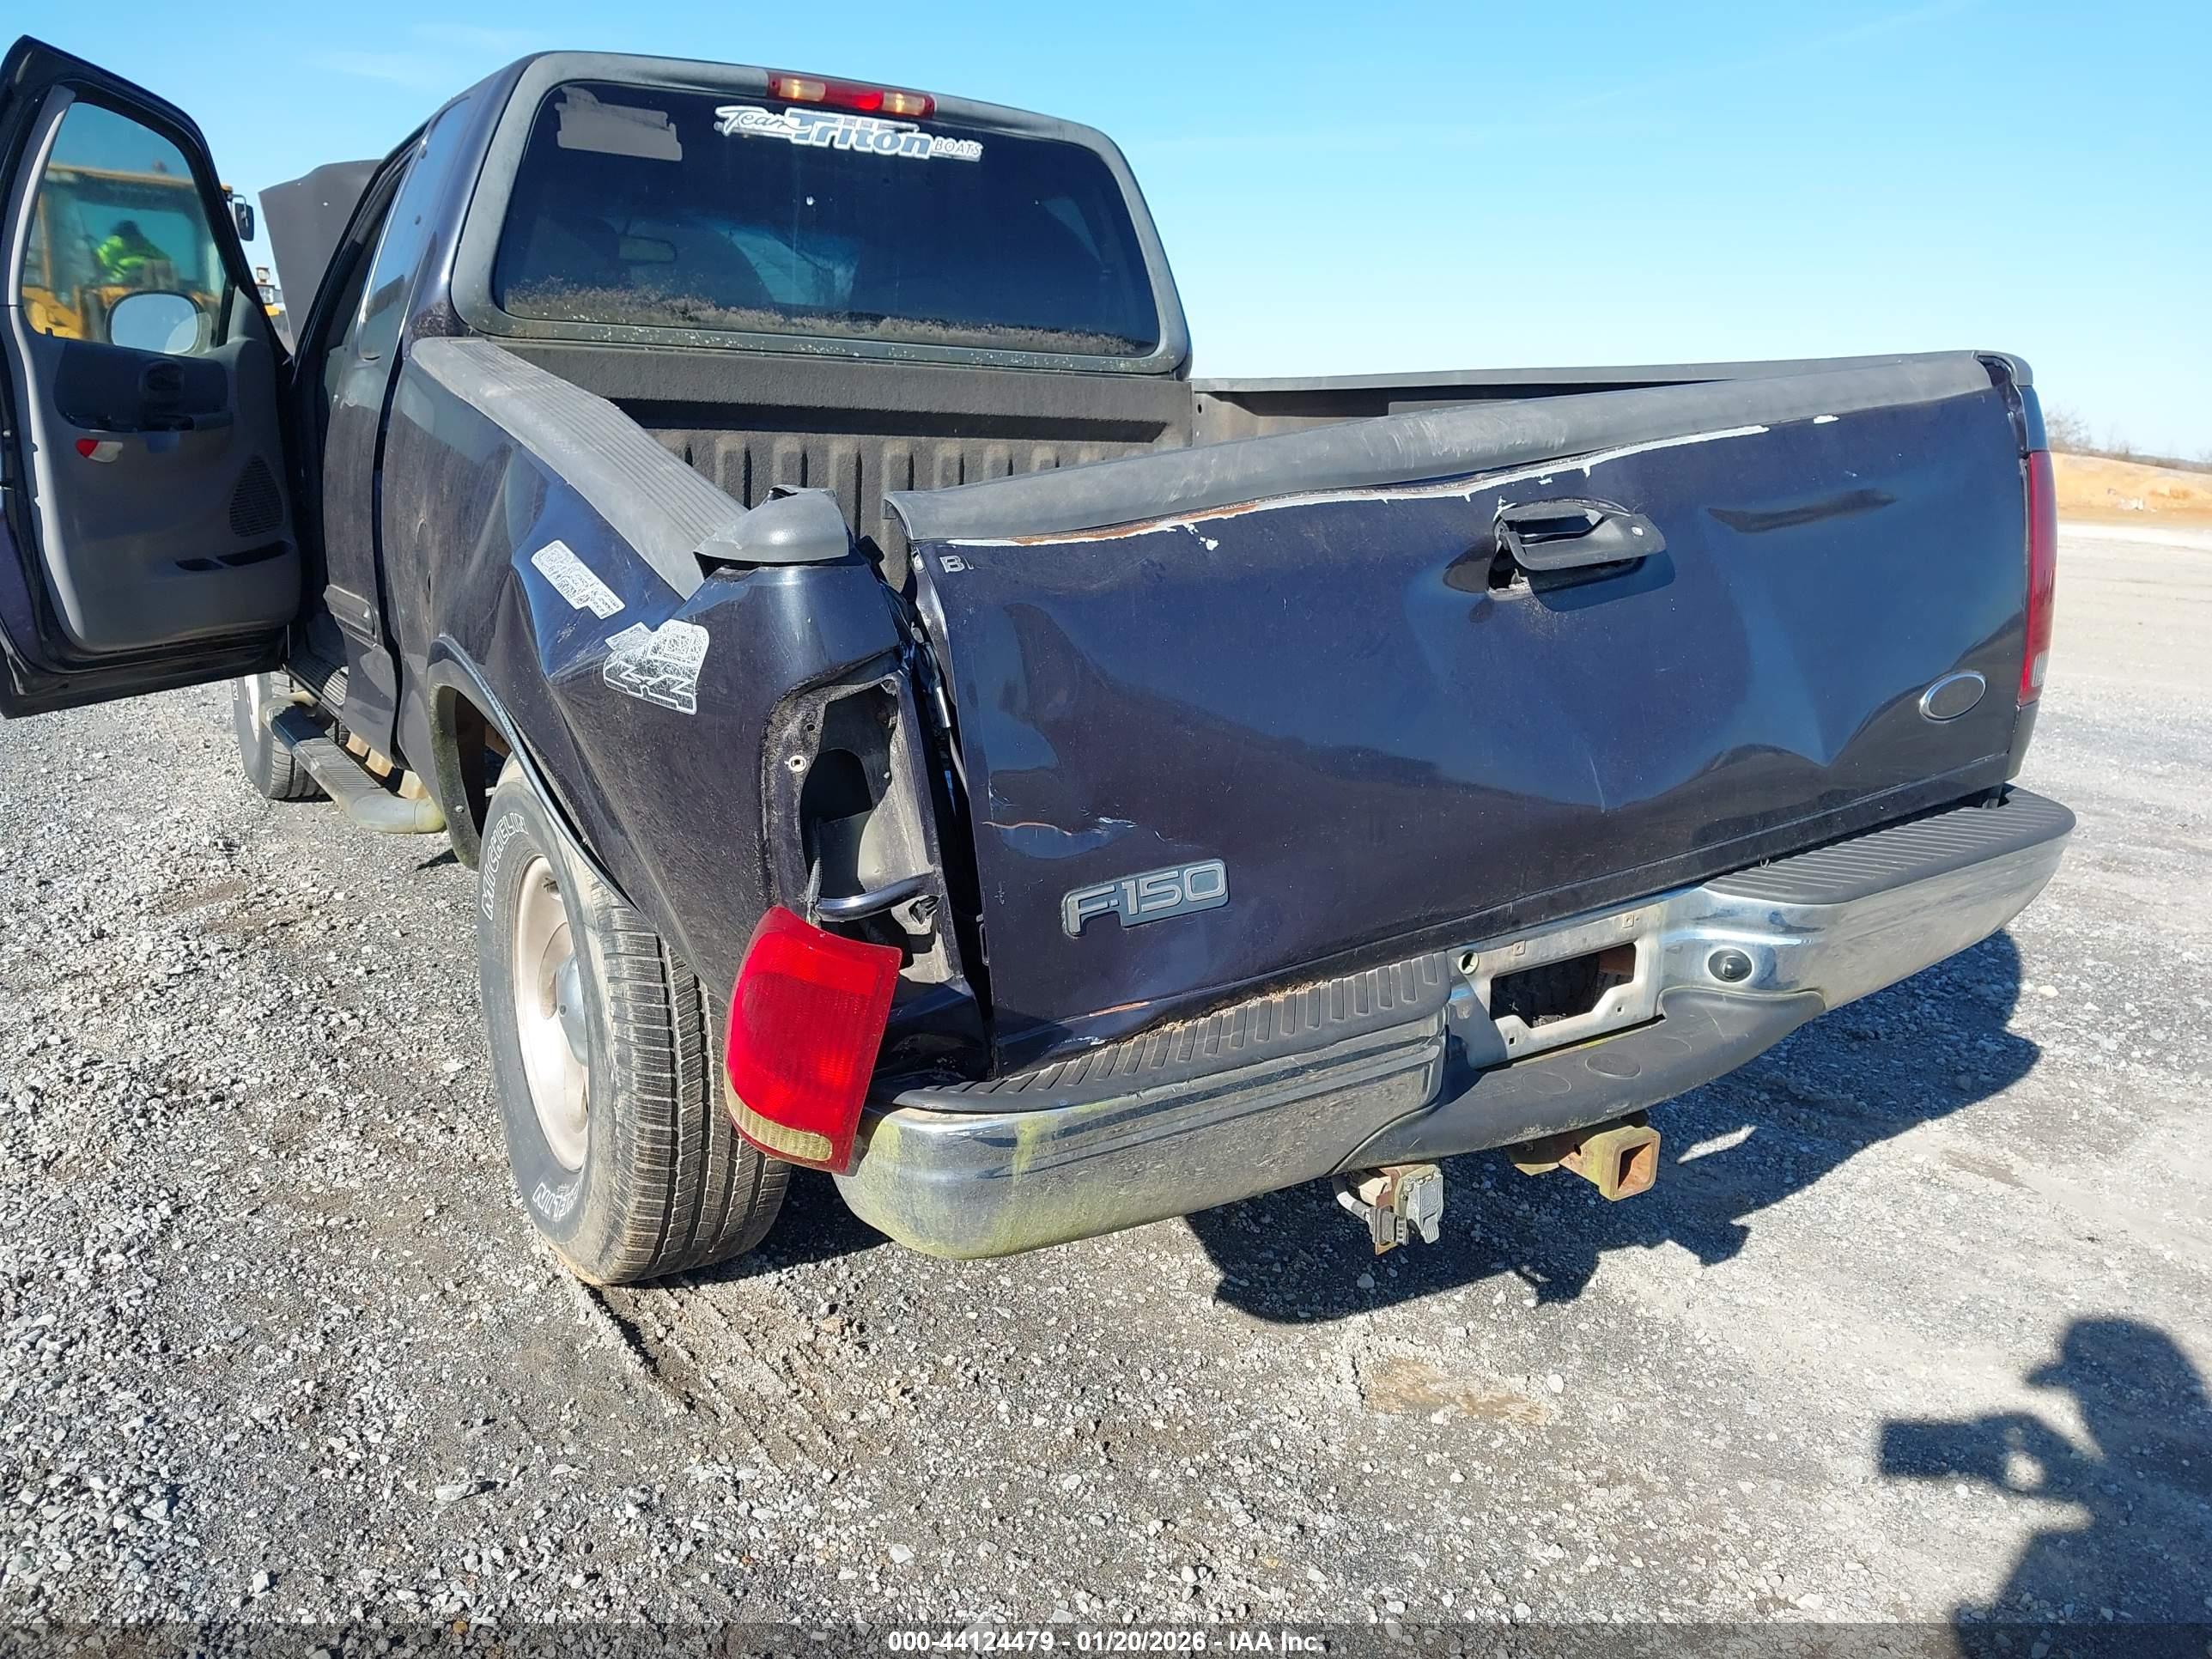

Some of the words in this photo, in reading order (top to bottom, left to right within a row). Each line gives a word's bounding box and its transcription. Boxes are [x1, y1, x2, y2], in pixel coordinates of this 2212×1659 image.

[716, 106, 797, 137] Team
[787, 110, 931, 158] Triton
[933, 139, 982, 157] BOATS
[481, 812, 530, 921] MICHELIN
[1066, 862, 1226, 934] F-150
